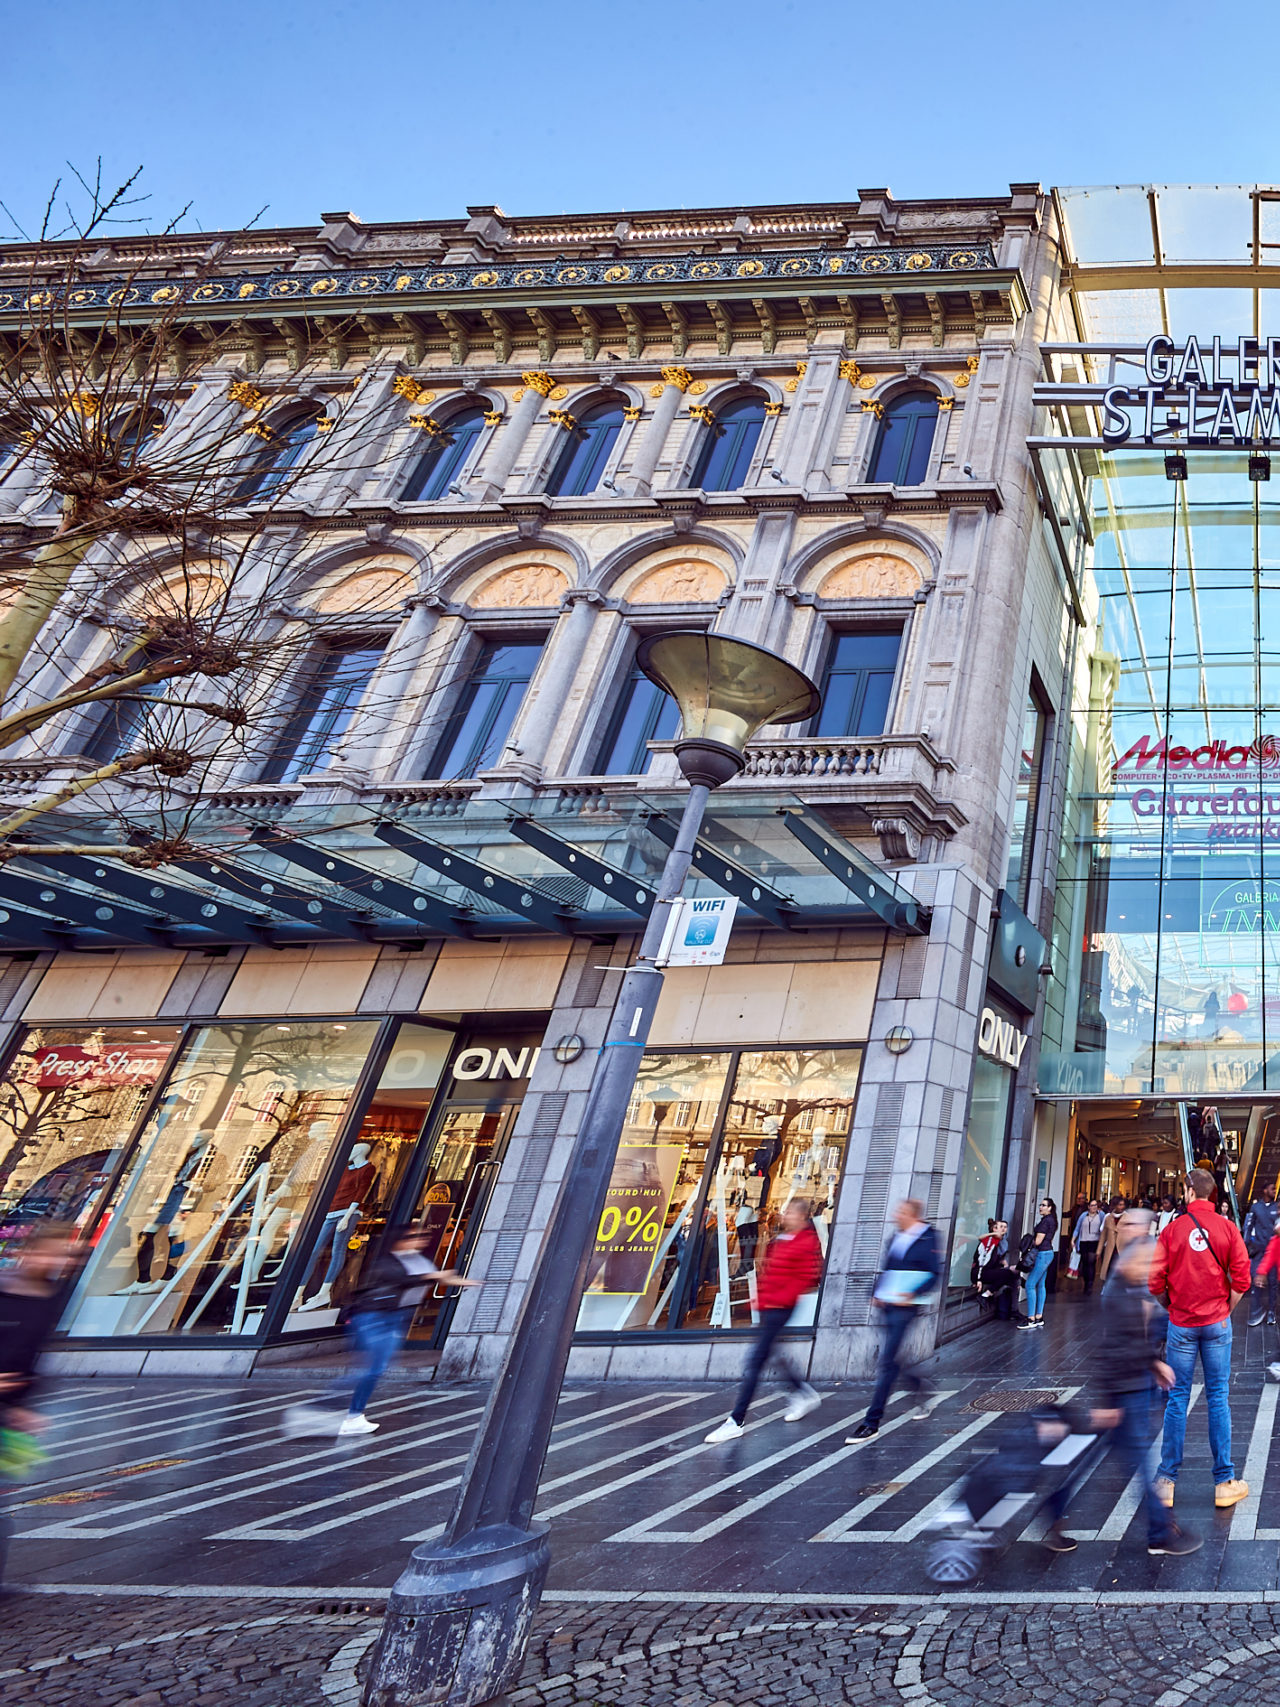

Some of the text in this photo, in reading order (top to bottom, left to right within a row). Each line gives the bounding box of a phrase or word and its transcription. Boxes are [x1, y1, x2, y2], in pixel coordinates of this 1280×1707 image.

[1111, 735, 1250, 770] Media
[1236, 772, 1252, 780] HIFI
[693, 900, 726, 912] WIFI
[1235, 892, 1279, 903] GALERIA
[979, 1007, 1028, 1068] ONLY
[33, 1051, 159, 1081] Press Shop
